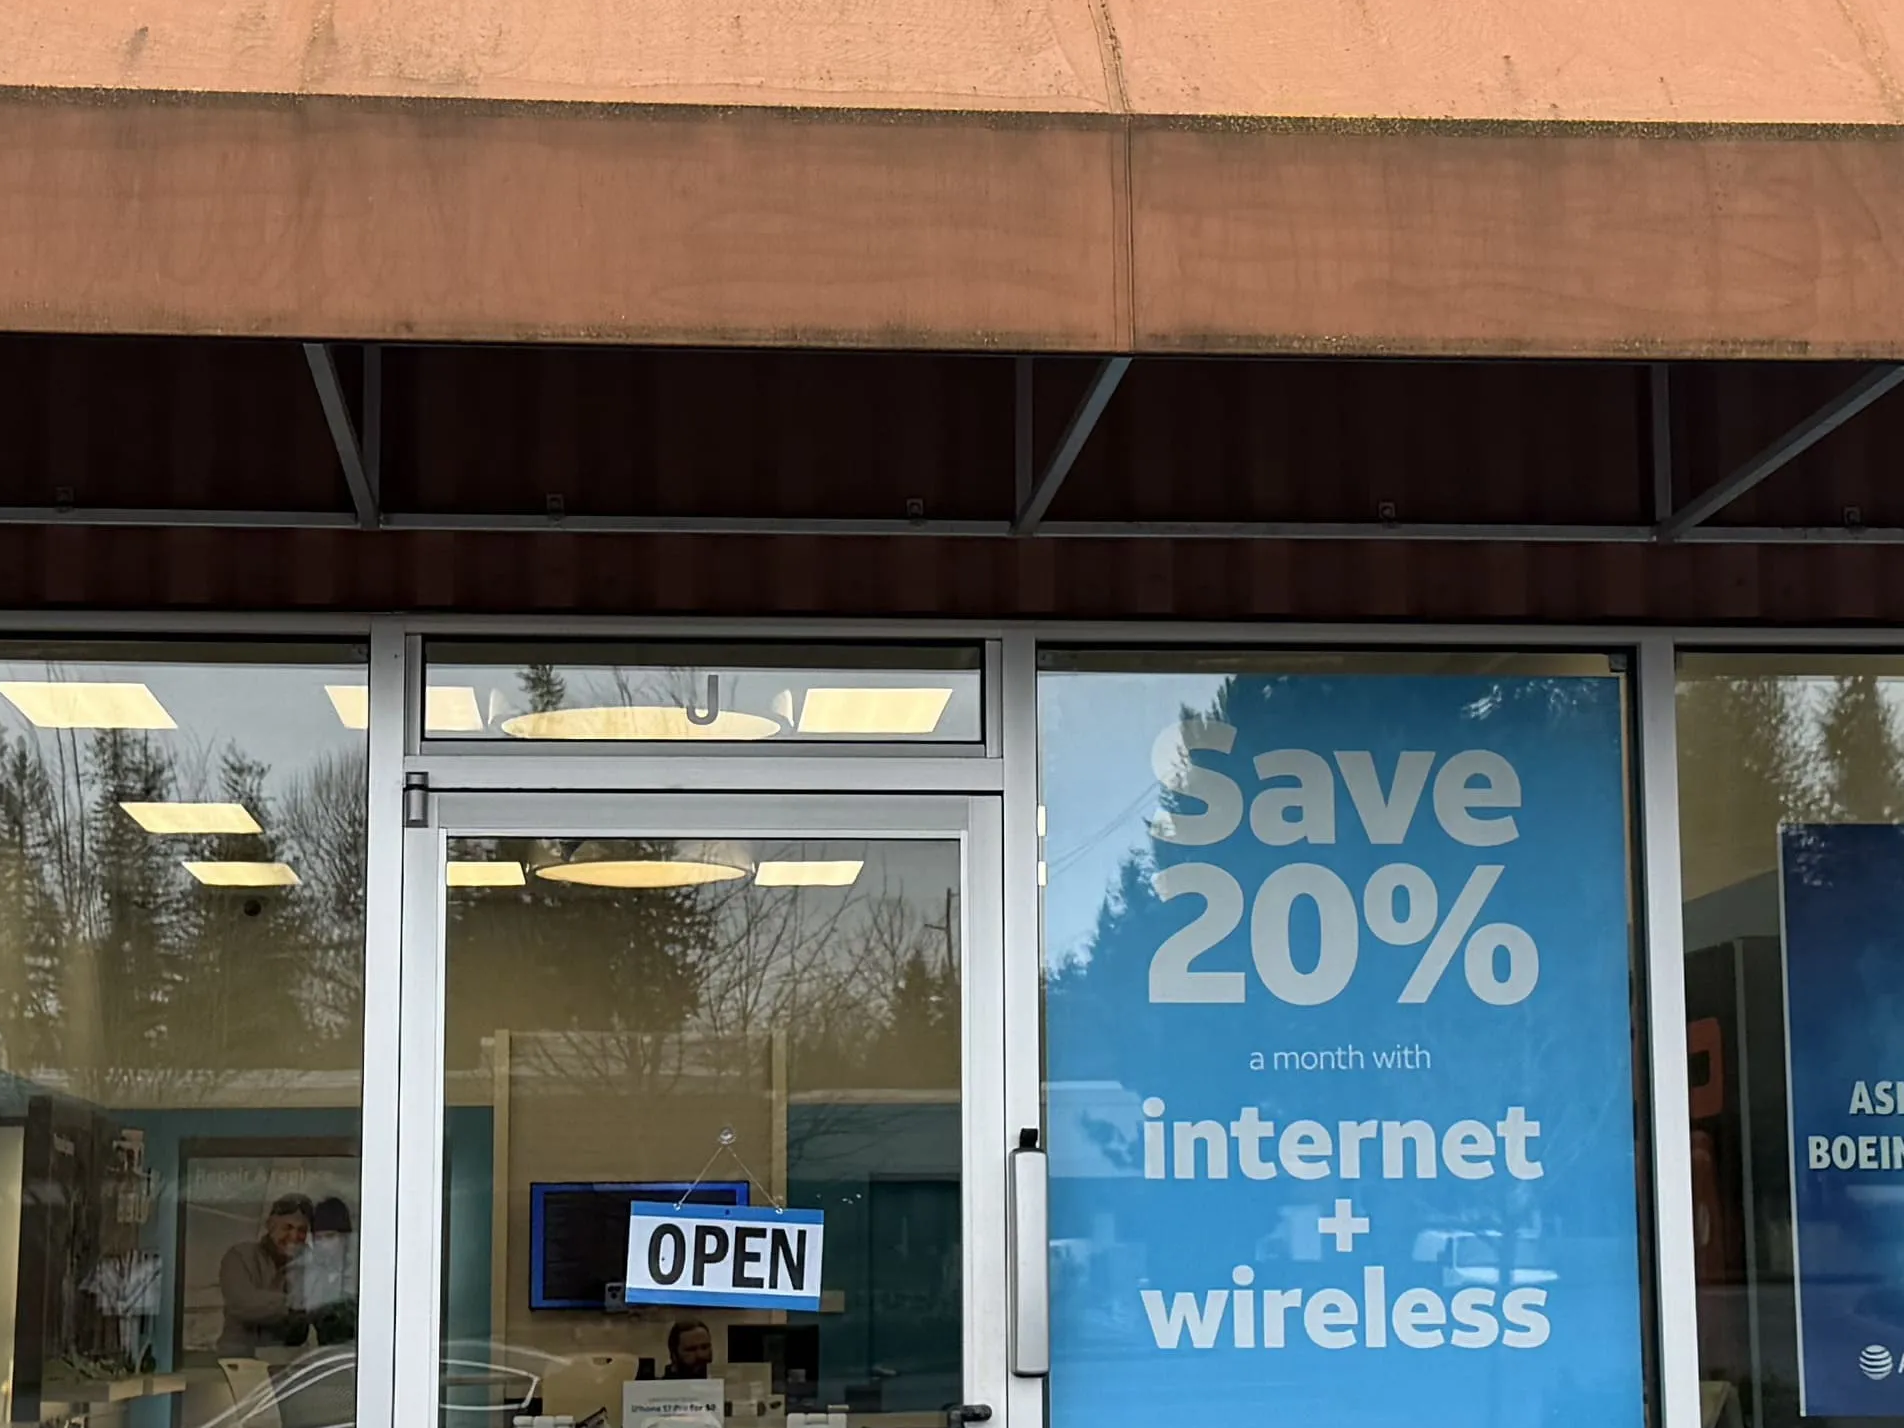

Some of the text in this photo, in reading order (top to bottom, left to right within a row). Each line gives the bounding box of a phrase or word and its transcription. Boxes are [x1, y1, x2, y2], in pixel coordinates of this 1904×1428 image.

[686, 674, 720, 726] J
[1149, 719, 1522, 847] Save
[1148, 861, 1540, 1006] 20%
[1248, 1042, 1432, 1070] a month with
[1142, 1096, 1545, 1181] internet
[647, 1222, 808, 1291] OPEN
[1317, 1198, 1370, 1252] +
[1139, 1264, 1552, 1349] wireless
